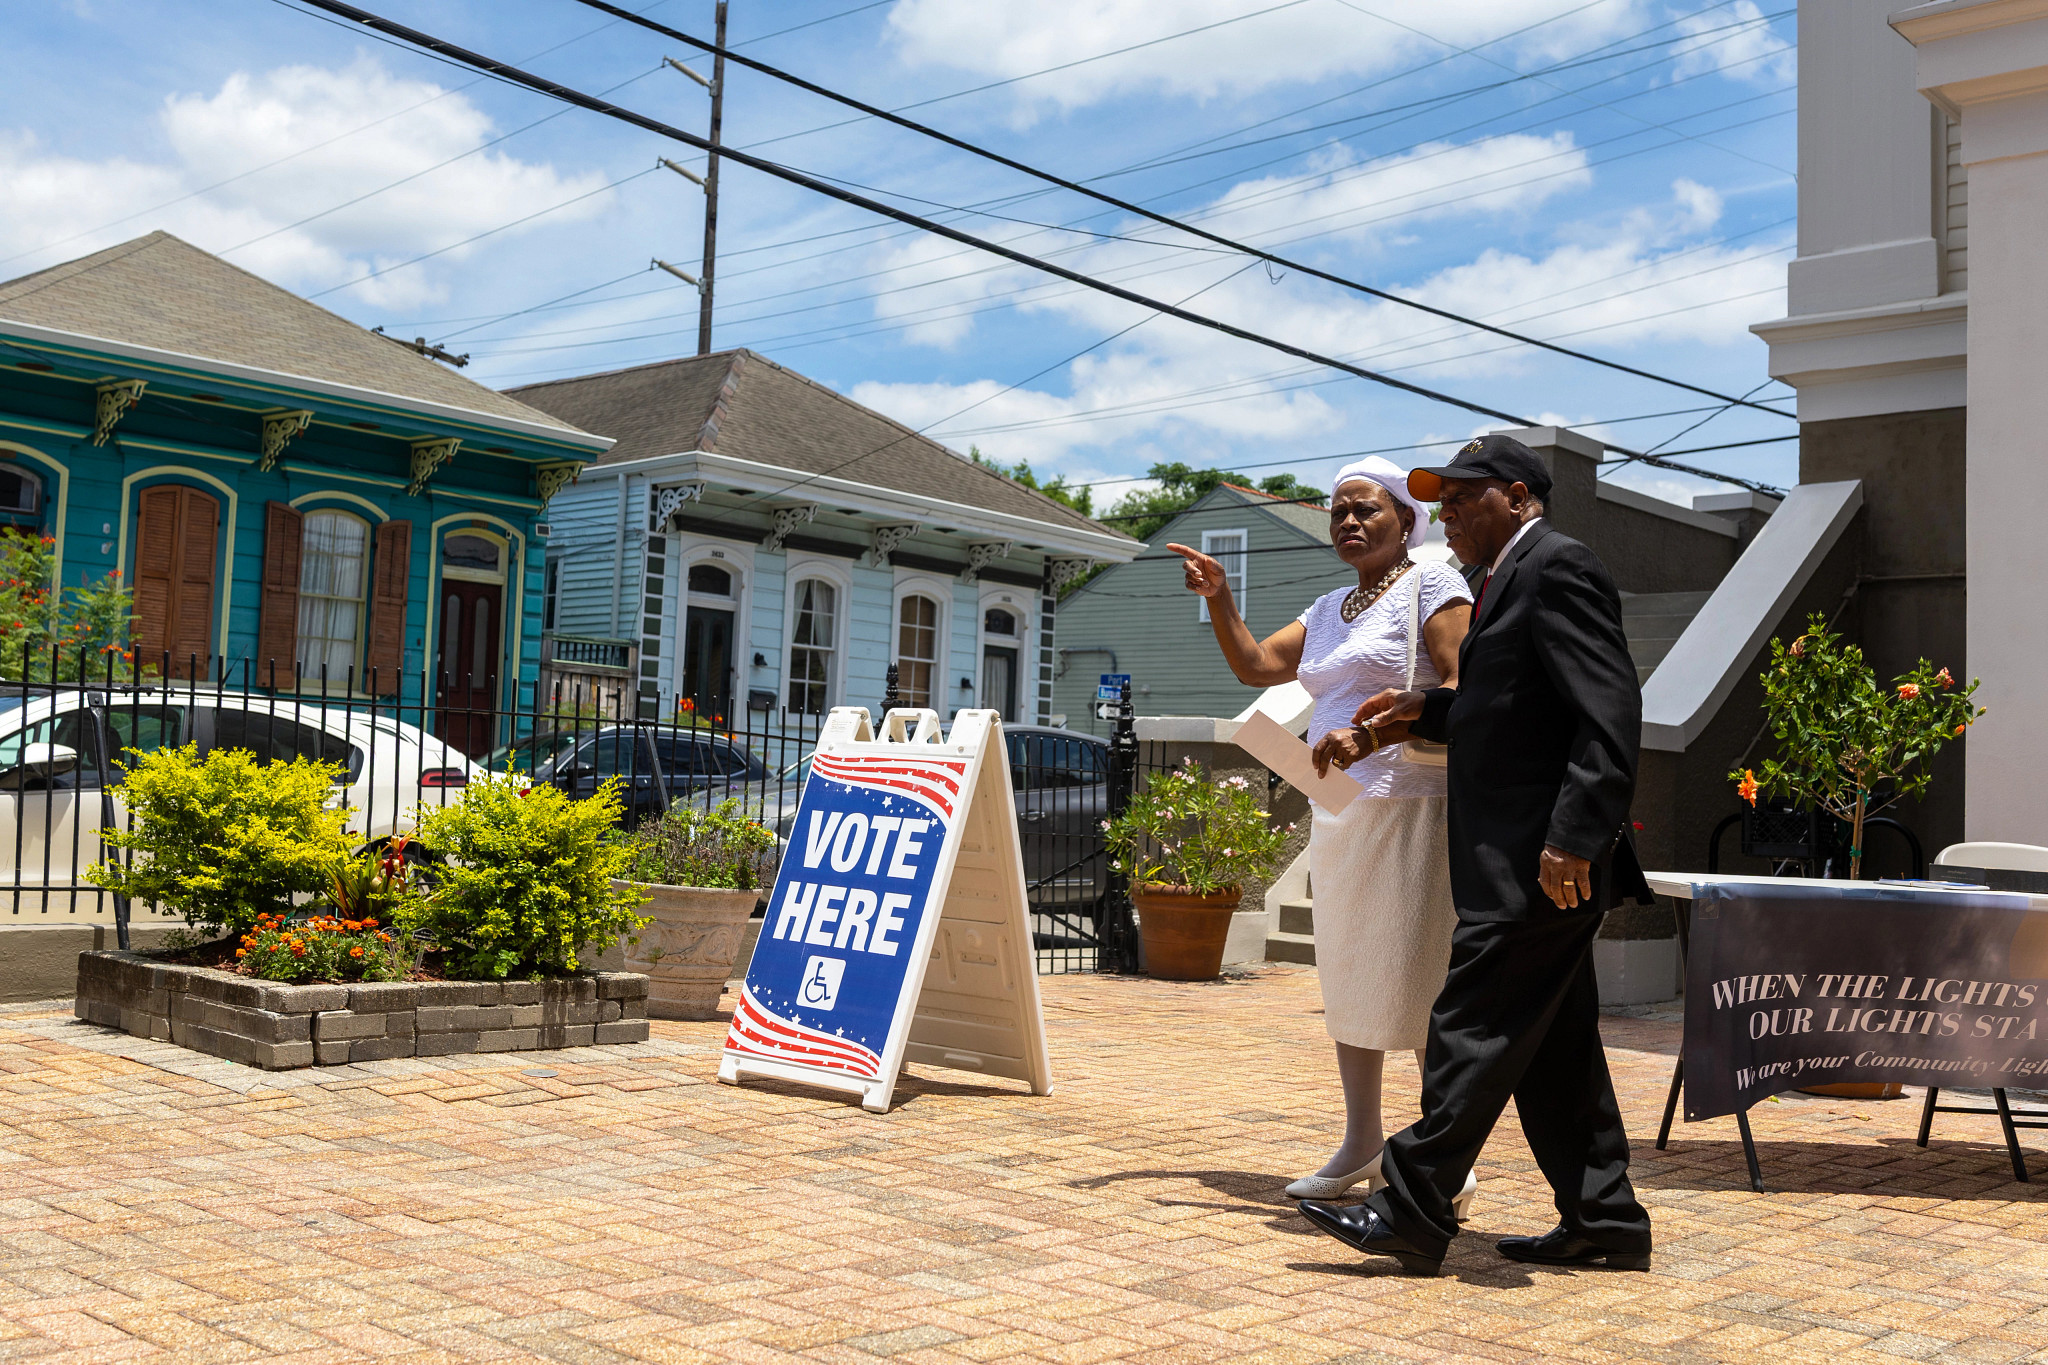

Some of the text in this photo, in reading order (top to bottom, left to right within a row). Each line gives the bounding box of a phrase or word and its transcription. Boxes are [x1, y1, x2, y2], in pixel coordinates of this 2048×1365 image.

[803, 810, 930, 880] VOTE
[772, 881, 912, 957] HERE
[1712, 974, 1807, 1010] WHEN
[1816, 974, 1888, 999] THE
[1895, 976, 2039, 1008] LIGHTS
[1750, 1007, 2048, 1040] OUR LIGHTS STA
[1758, 1060, 1792, 1080] are
[1792, 1054, 1850, 1077] your
[1854, 1050, 1996, 1078] Community
